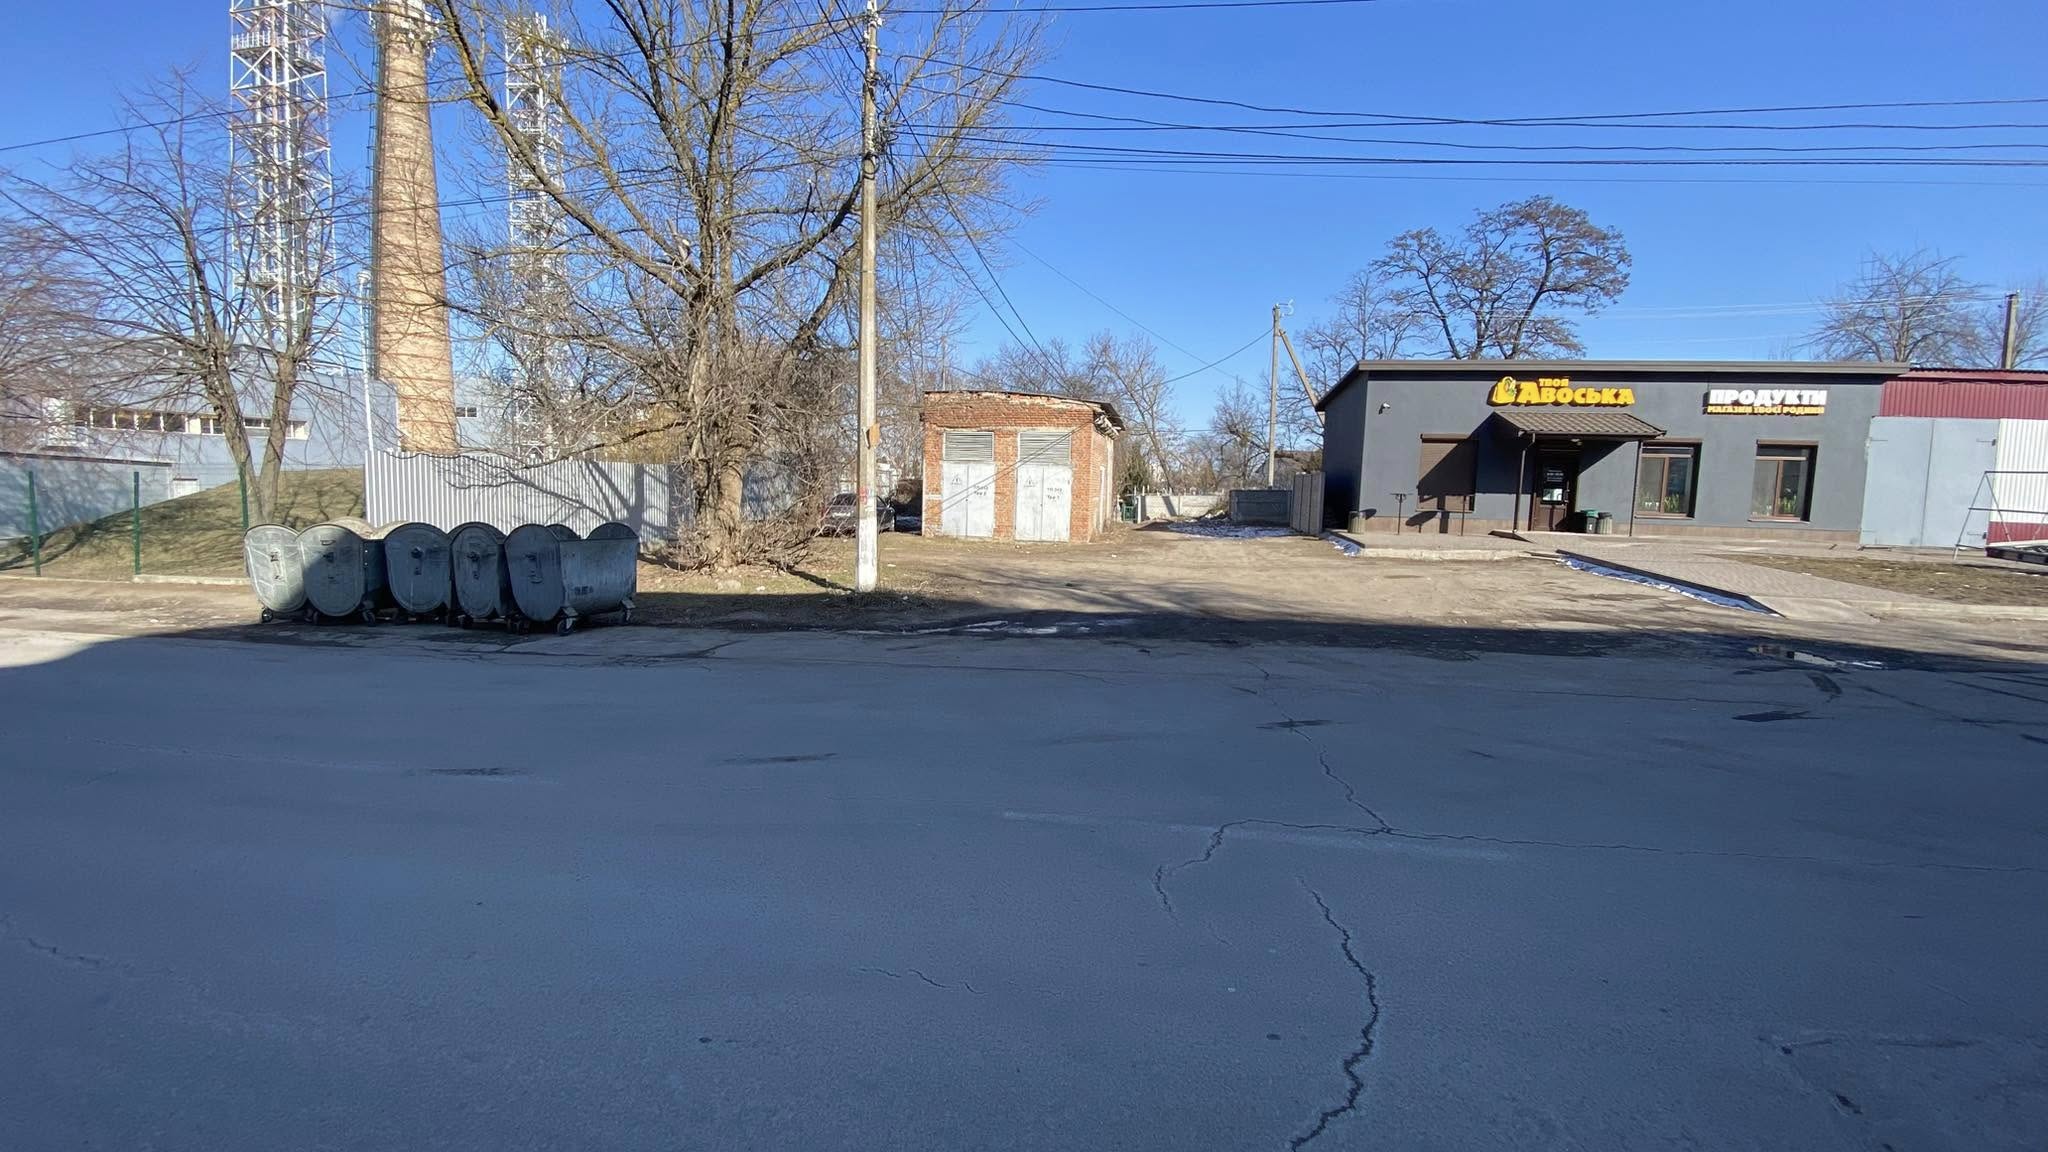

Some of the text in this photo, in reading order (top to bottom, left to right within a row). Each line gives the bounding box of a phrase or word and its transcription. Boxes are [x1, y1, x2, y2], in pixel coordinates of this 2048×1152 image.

[1539, 378, 1569, 387] ТВОЯ
[1516, 382, 1635, 405] АВОСЬКА
[1709, 389, 1827, 407] ПРОДУКТИ
